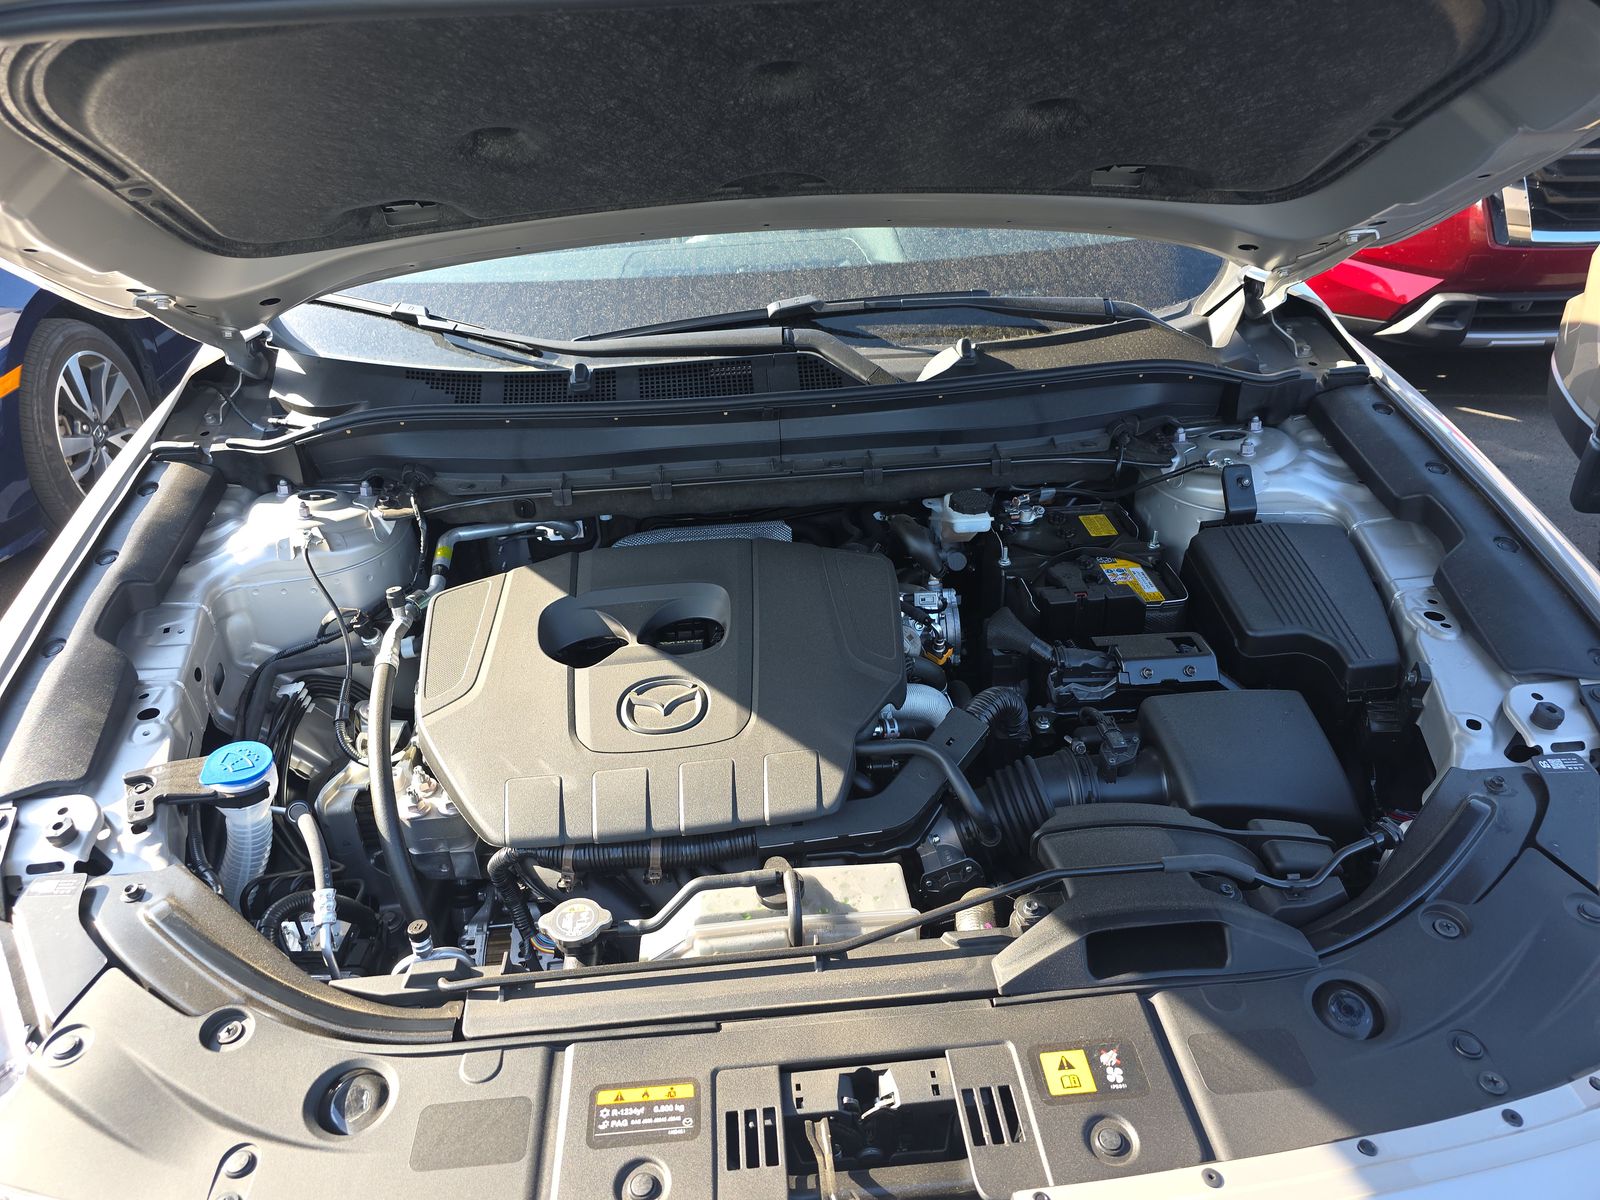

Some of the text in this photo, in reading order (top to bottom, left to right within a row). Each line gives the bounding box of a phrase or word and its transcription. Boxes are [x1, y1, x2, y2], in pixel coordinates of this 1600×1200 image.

[611, 1106, 645, 1117] R-1234yf
[674, 1103, 685, 1113] kg
[610, 1118, 629, 1128] PAG
